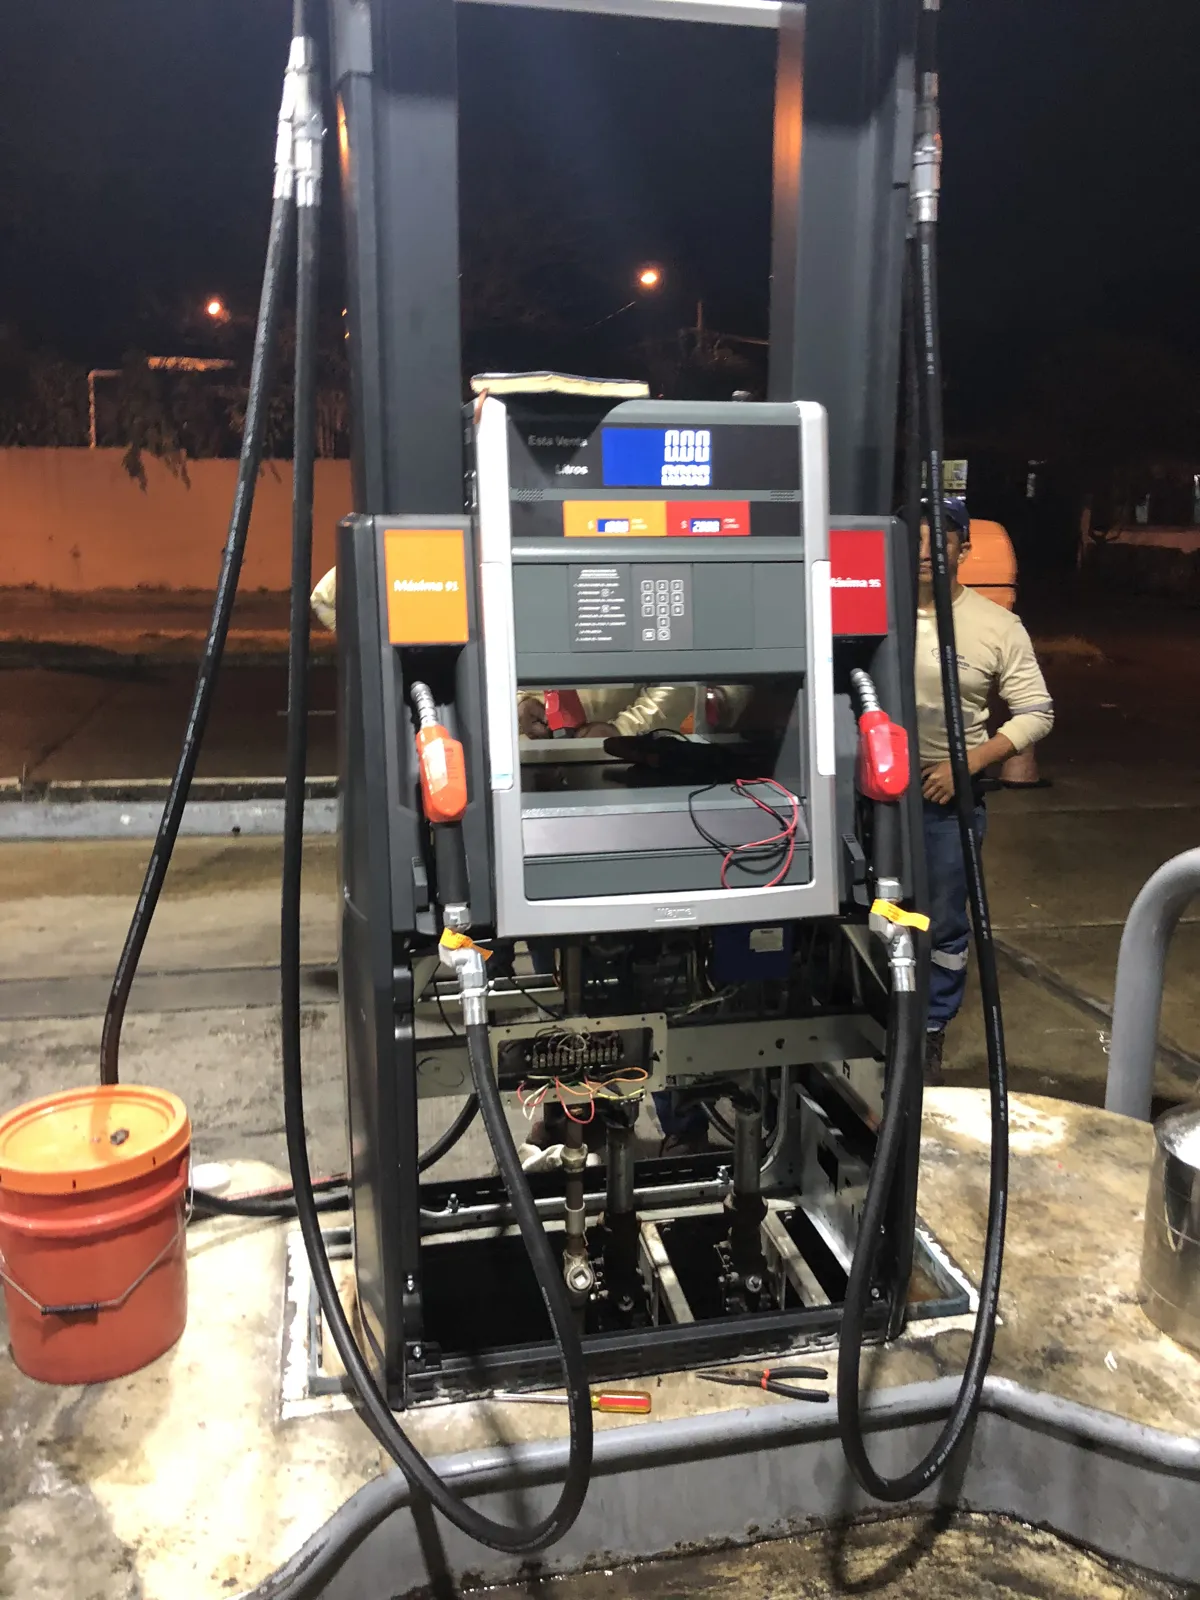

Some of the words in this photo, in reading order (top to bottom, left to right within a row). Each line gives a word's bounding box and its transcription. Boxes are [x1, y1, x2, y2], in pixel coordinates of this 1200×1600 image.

[528, 434, 553, 447] Esta
[555, 435, 588, 447] Venta
[555, 464, 589, 475] Litros
